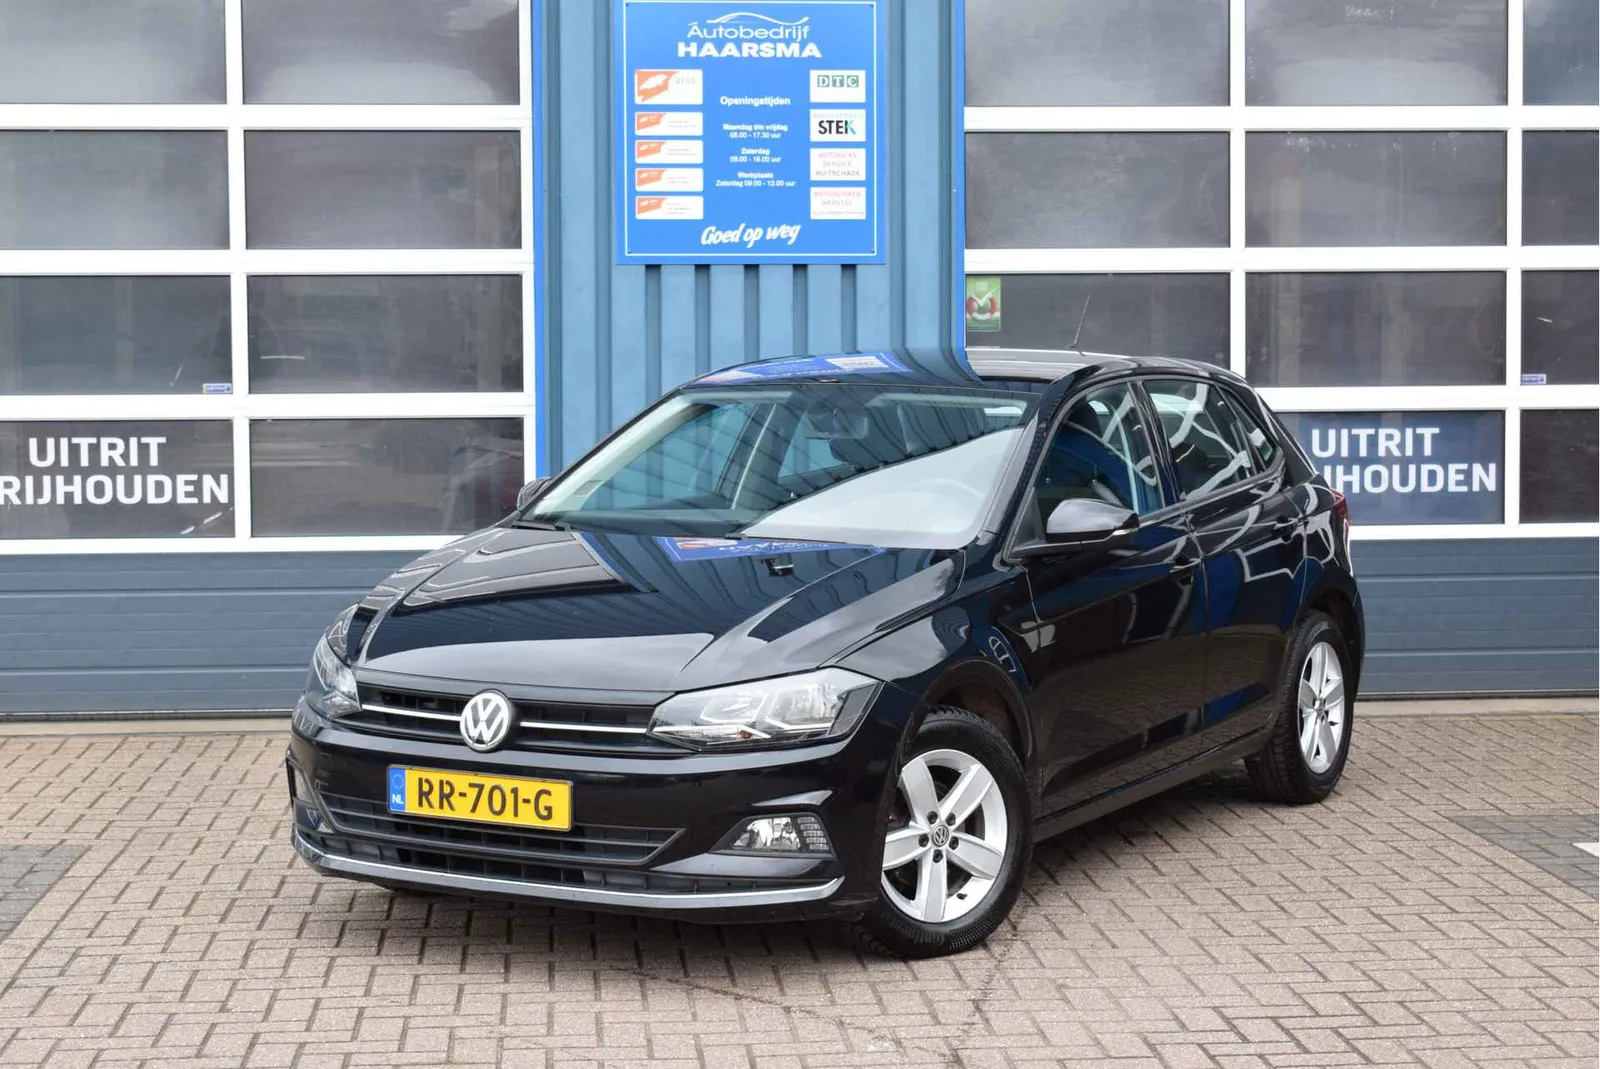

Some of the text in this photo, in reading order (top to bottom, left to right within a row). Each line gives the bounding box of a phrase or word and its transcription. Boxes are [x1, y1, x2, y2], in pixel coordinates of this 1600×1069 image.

[687, 24, 810, 41] Autobedrijf
[677, 42, 822, 58] HAARSMA
[817, 75, 859, 87] DTC
[720, 96, 791, 107] Openingstijden
[818, 120, 856, 135] STEK
[701, 223, 802, 249] Goed op weg
[1312, 428, 1440, 458] UITRIT
[29, 437, 166, 468] UITRIT
[391, 793, 404, 805] NL
[417, 776, 553, 822] RR-701-G
